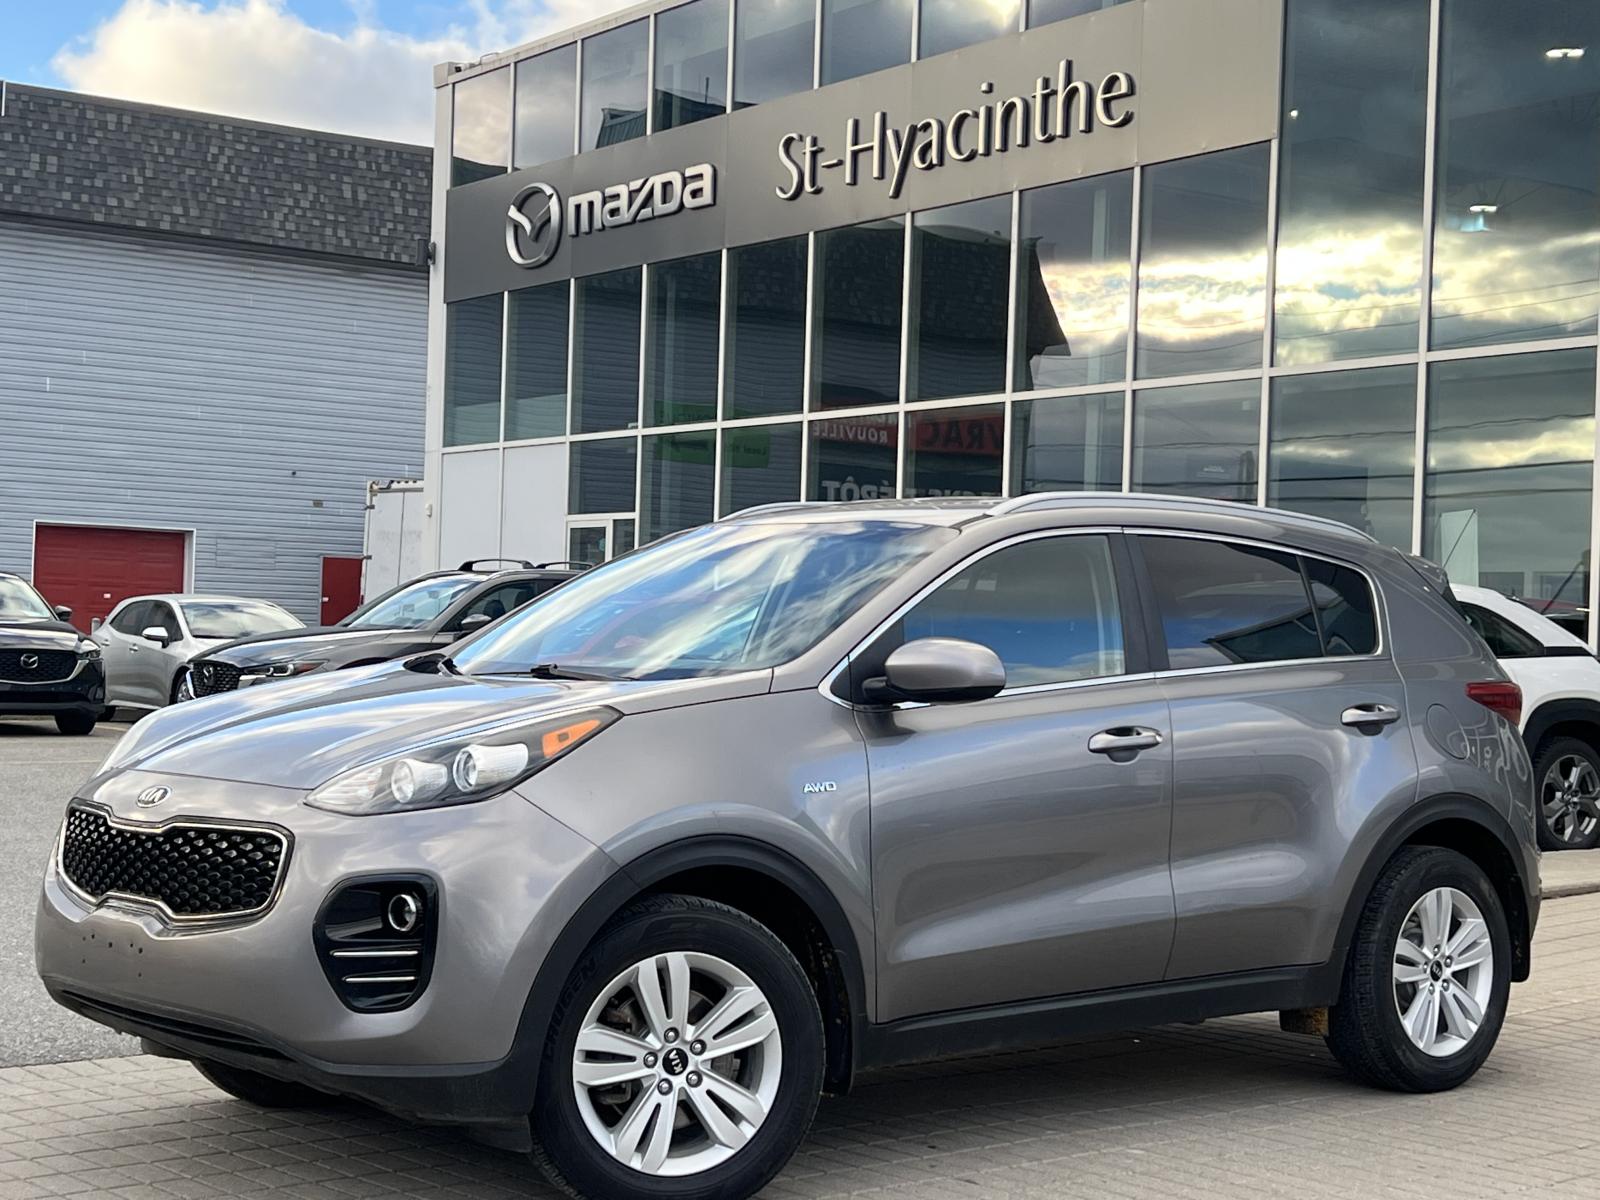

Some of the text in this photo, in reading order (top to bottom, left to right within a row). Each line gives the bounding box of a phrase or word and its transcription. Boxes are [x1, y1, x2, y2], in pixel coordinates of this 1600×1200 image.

[775, 58, 1136, 201] St-Hyacinthe
[567, 162, 716, 237] mazda
[138, 787, 166, 802] KIA
[803, 781, 837, 793] AWD
[669, 1049, 683, 1074] KIA
